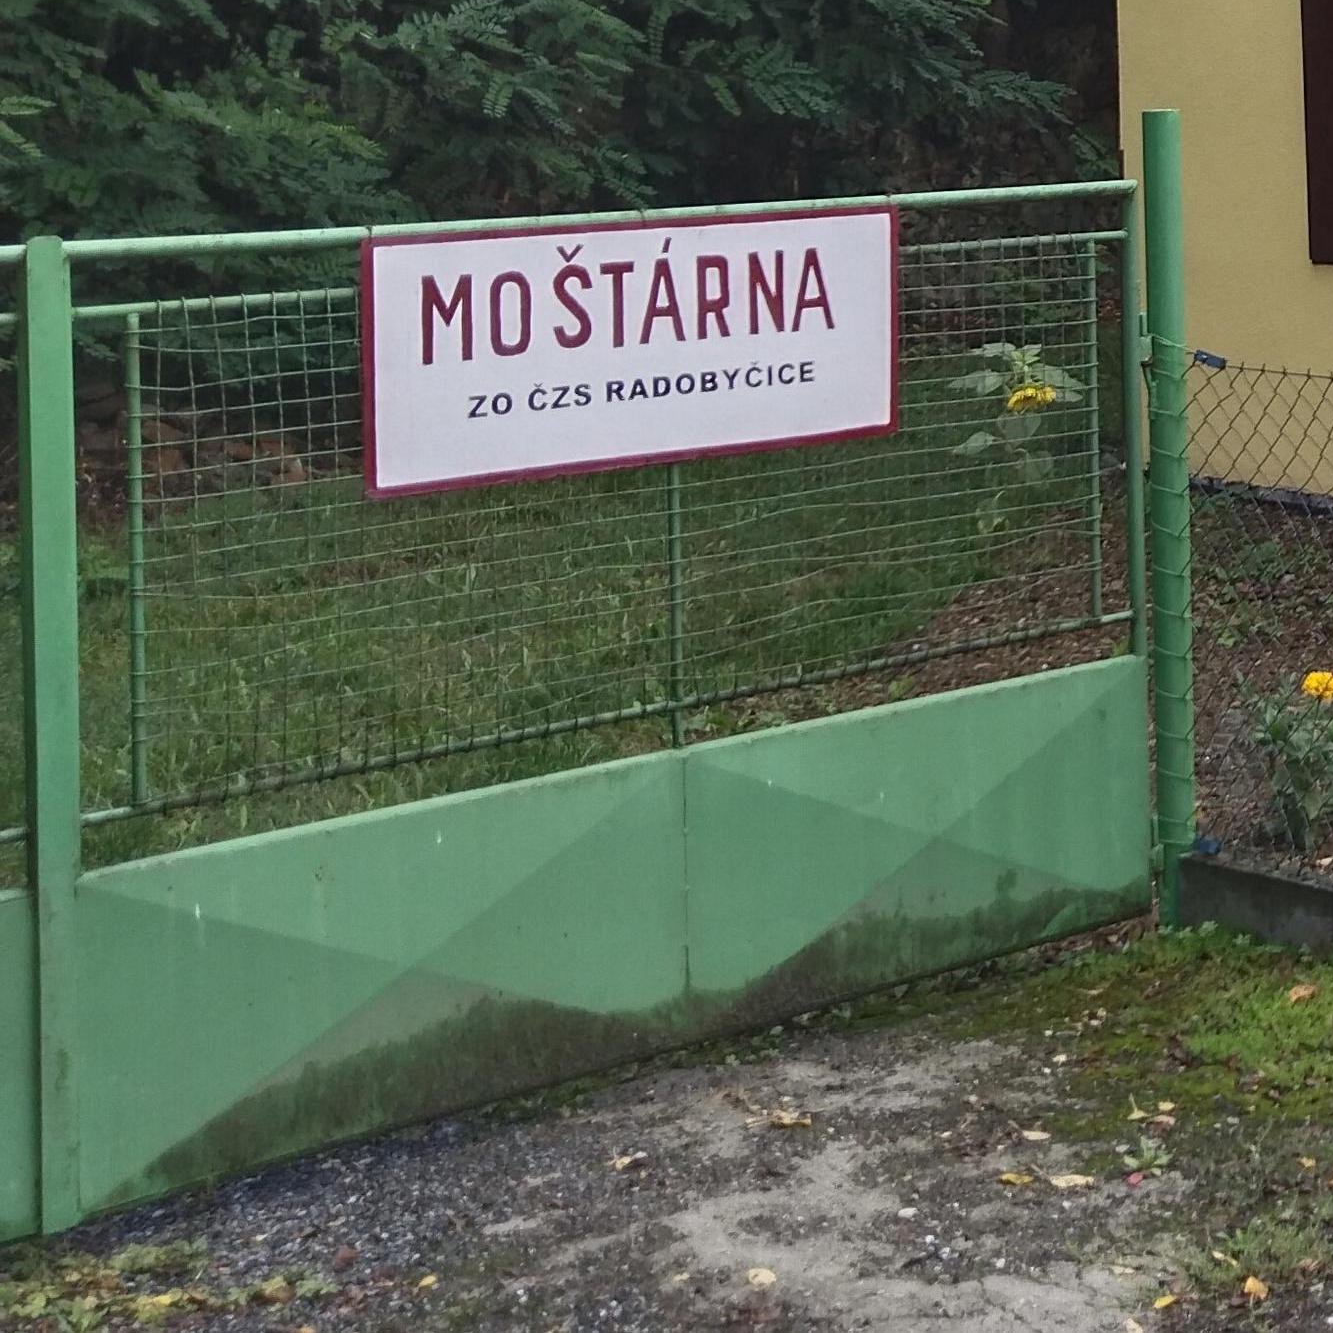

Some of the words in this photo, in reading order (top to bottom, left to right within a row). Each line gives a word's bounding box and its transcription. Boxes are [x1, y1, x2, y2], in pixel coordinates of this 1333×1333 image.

[421, 237, 835, 365] MOŠTÁRNA
[468, 393, 513, 419] ZO
[528, 382, 592, 411] ČZS
[605, 361, 815, 403] RADOBYČICE
